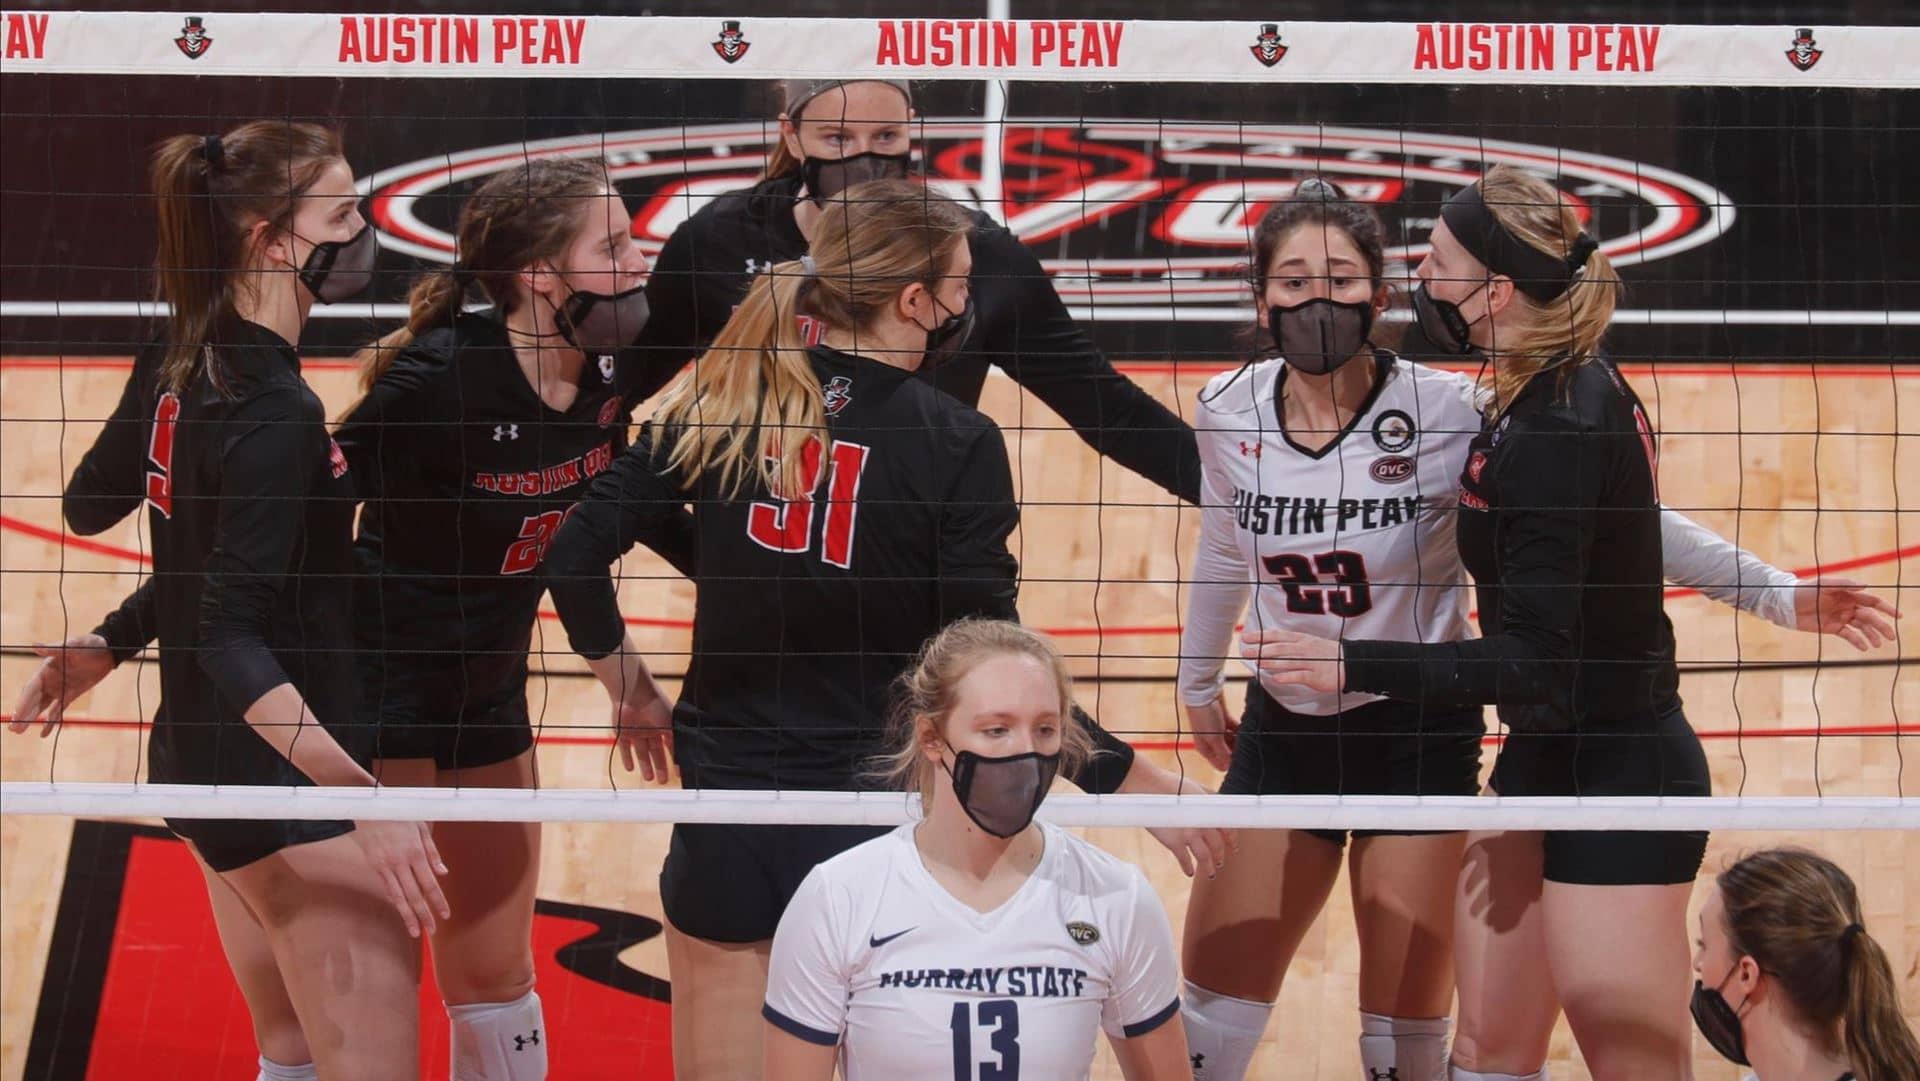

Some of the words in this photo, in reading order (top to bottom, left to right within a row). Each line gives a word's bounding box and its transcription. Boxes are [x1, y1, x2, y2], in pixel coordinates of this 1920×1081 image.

[0, 14, 49, 59] AY
[338, 16, 480, 64] AUSTIN
[493, 18, 587, 65] PEAY
[876, 20, 1018, 68] AUSTIN
[1030, 21, 1124, 68] PEAY
[1413, 24, 1555, 71] AUSTIN
[1568, 25, 1660, 73] PEAY
[746, 433, 870, 570] 31
[1233, 486, 1328, 536] USTIN
[1337, 494, 1424, 532] PEAY
[501, 502, 580, 575] 2
[1261, 550, 1373, 618] 23
[879, 967, 1003, 994] MURRAY
[1007, 966, 1088, 998] STATE
[950, 999, 1021, 1081] 13
